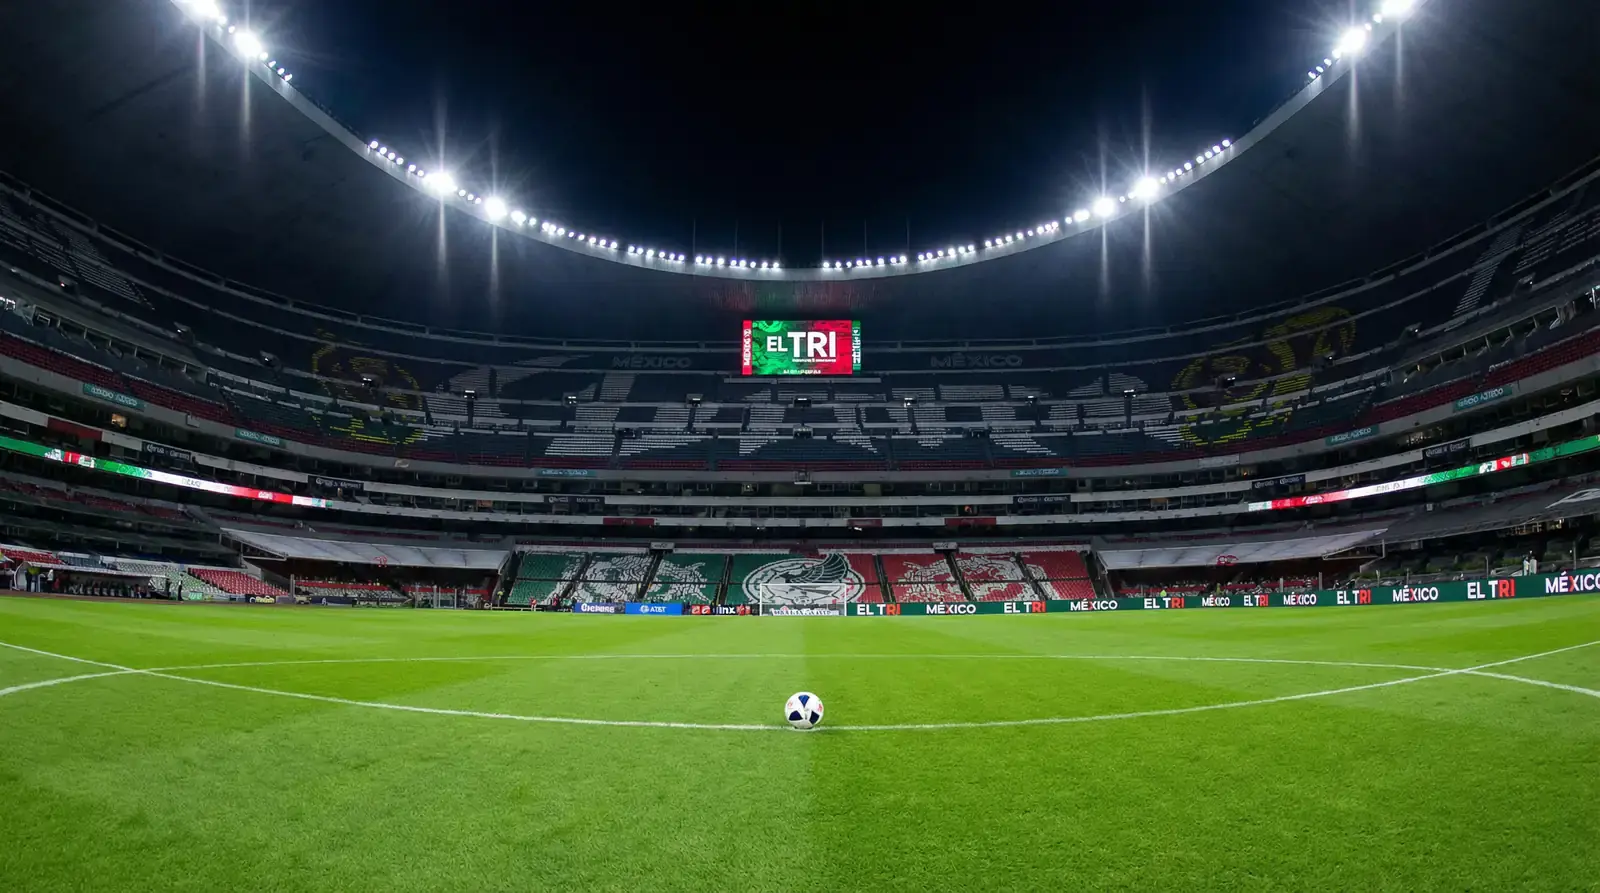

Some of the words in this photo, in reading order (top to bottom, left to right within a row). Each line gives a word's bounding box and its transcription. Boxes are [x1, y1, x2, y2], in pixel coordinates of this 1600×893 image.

[766, 336, 788, 352] EL
[787, 331, 837, 358] TRI
[613, 354, 692, 369] MÉXICO
[930, 353, 1023, 368] MÉXICO
[1393, 585, 1439, 602] MÉXICO
[1467, 582, 1486, 599] EL
[1488, 579, 1515, 598] TRI
[1144, 598, 1160, 609] EL
[1162, 597, 1184, 608] TRI
[1202, 594, 1230, 607] MÉXICO
[1243, 595, 1253, 606] EL
[1254, 594, 1269, 606] TRI
[1283, 592, 1317, 605] MÉXICO
[1337, 590, 1350, 605] EL
[1352, 589, 1371, 604] TRI
[857, 604, 874, 615] EL
[876, 603, 901, 615] TRI
[926, 602, 976, 614] MÉXICO
[1004, 602, 1020, 613] EL
[1023, 601, 1046, 613] TRI
[1070, 599, 1118, 611] MÉXICO
